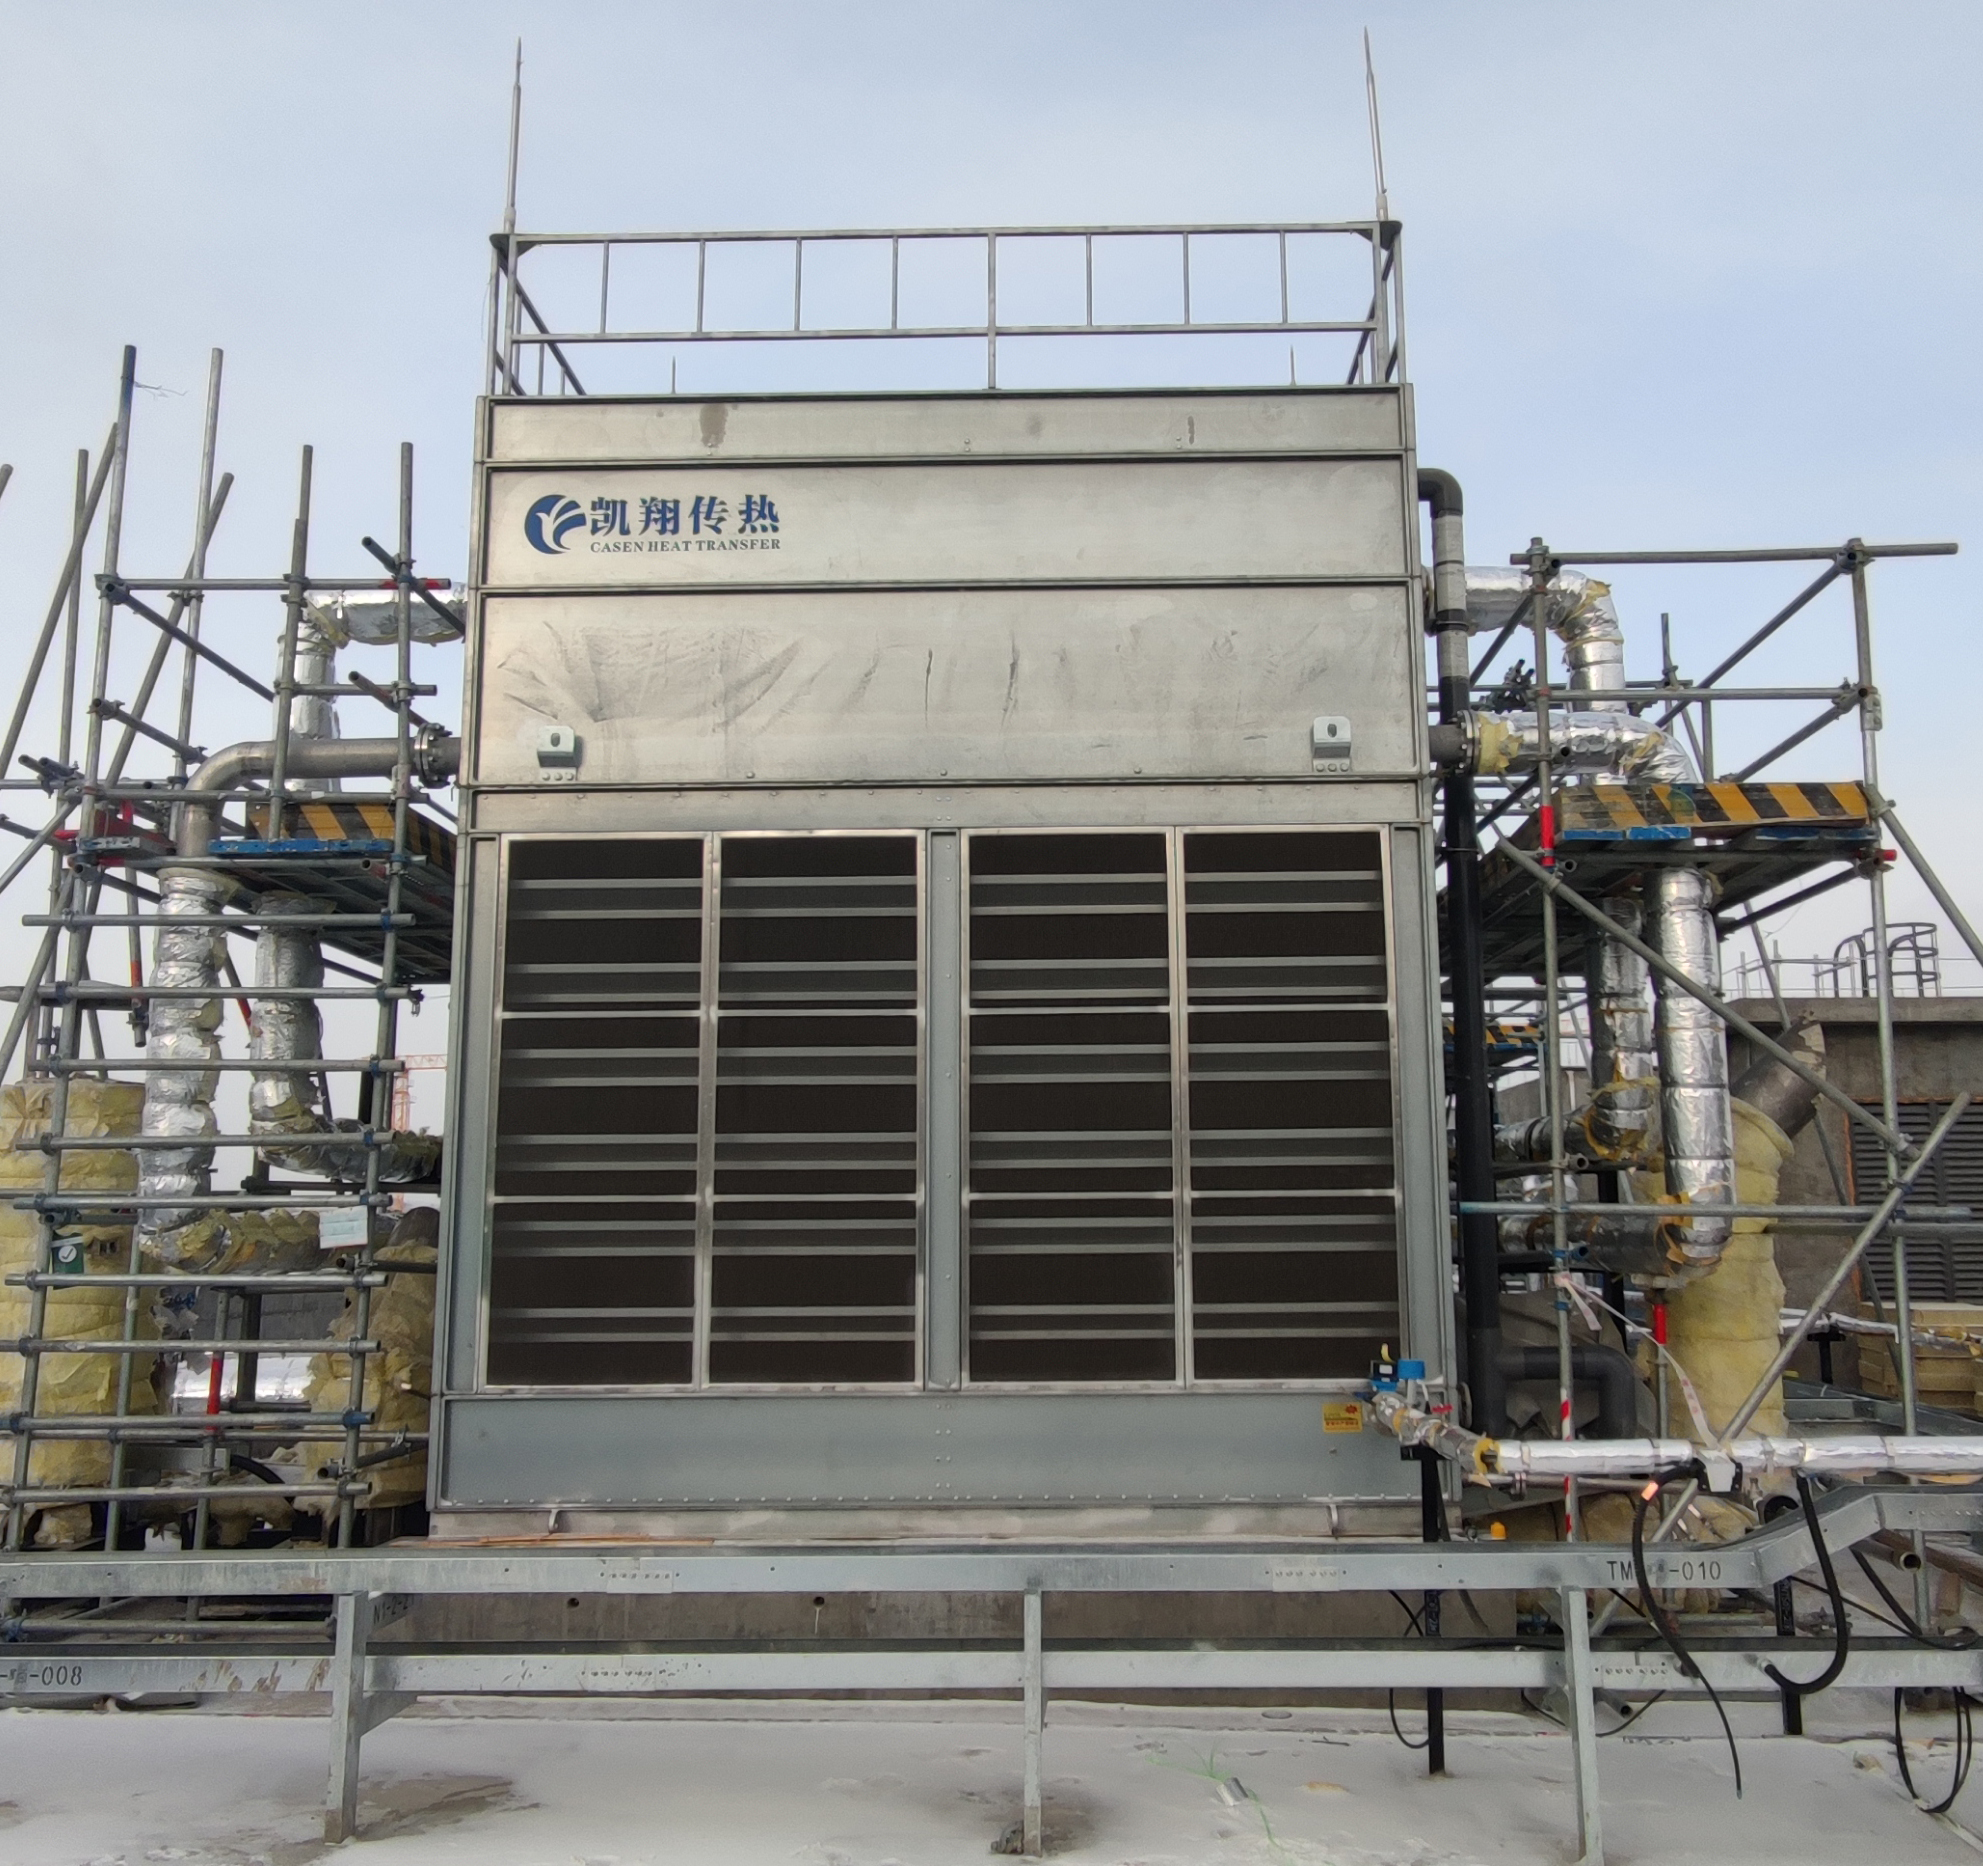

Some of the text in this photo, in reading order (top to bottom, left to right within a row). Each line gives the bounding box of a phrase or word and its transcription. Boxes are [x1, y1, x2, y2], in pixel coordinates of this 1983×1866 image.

[590, 494, 780, 537] 凯翔传热
[590, 538, 781, 553] CASEN HEAT TRANSFER
[1606, 1560, 1721, 1581] TM-010
